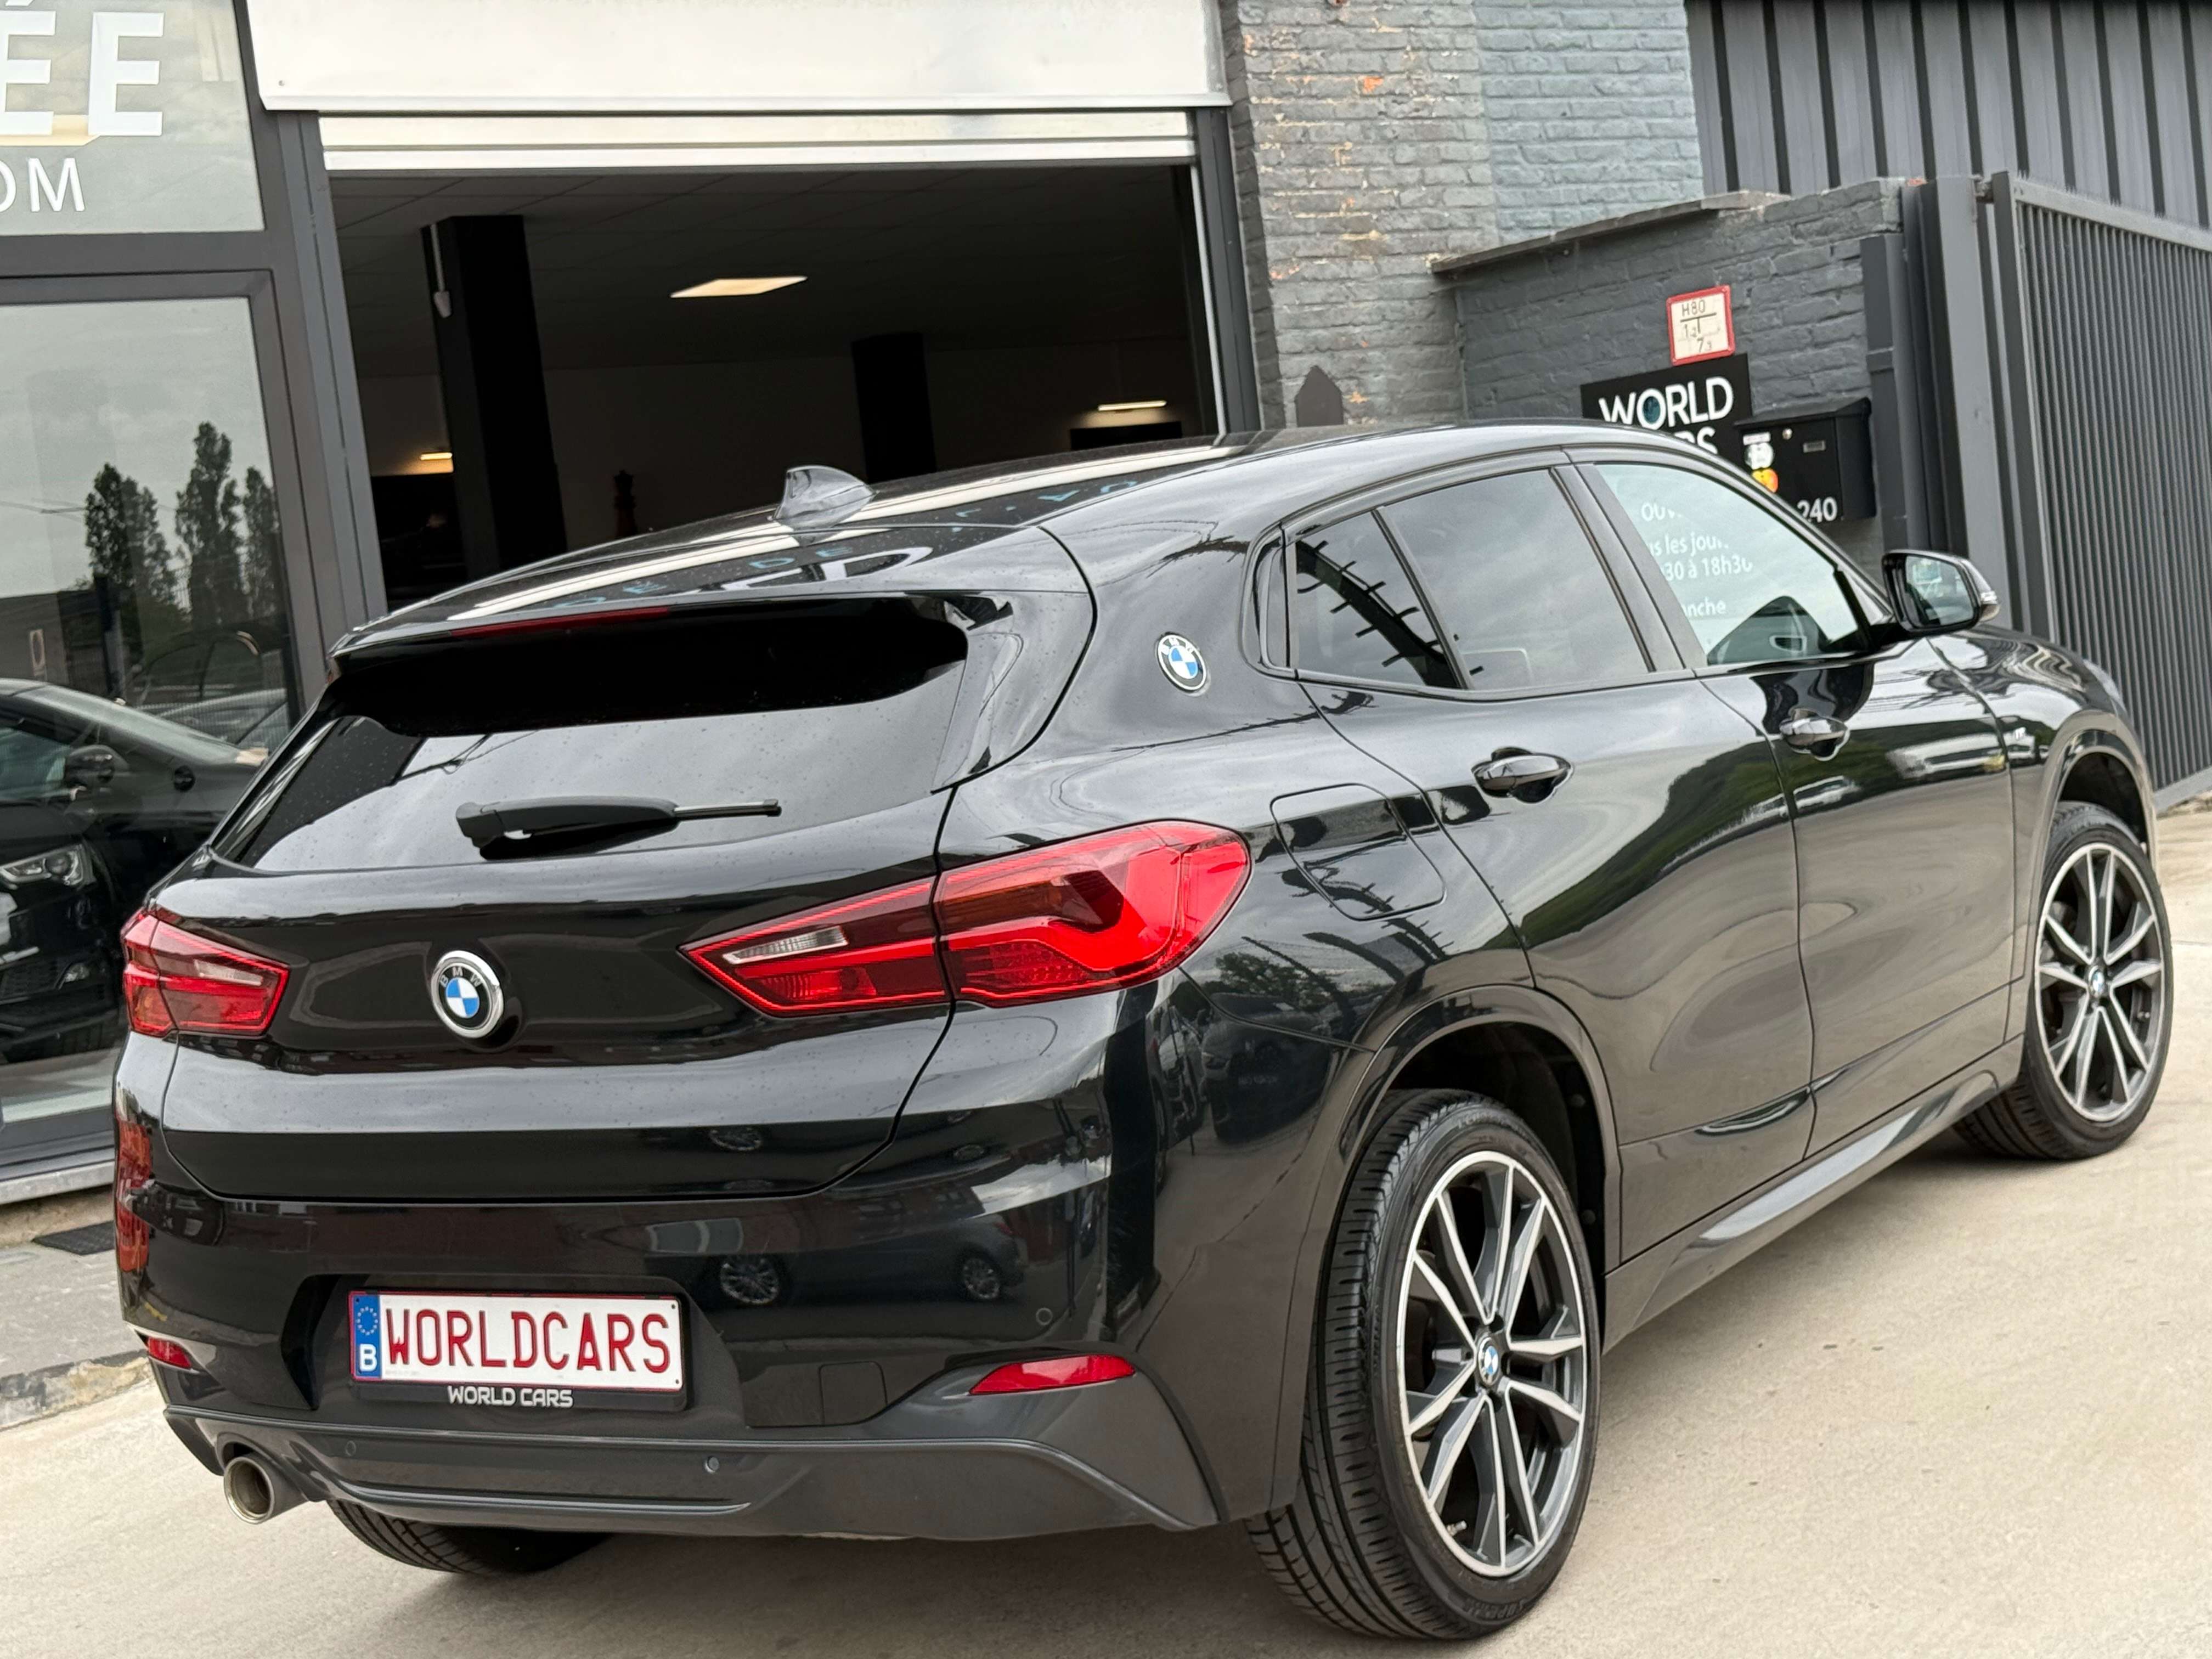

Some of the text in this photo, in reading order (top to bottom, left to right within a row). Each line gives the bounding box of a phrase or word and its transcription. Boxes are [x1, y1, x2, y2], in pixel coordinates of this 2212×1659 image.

[1598, 376, 1734, 431] WORLD
[1664, 533, 1688, 554] les
[1688, 557, 1698, 579] à
[440, 966, 483, 988] BMW
[359, 1308, 669, 1374] B WORLDCARS
[447, 1385, 574, 1409] WORLD CARS
